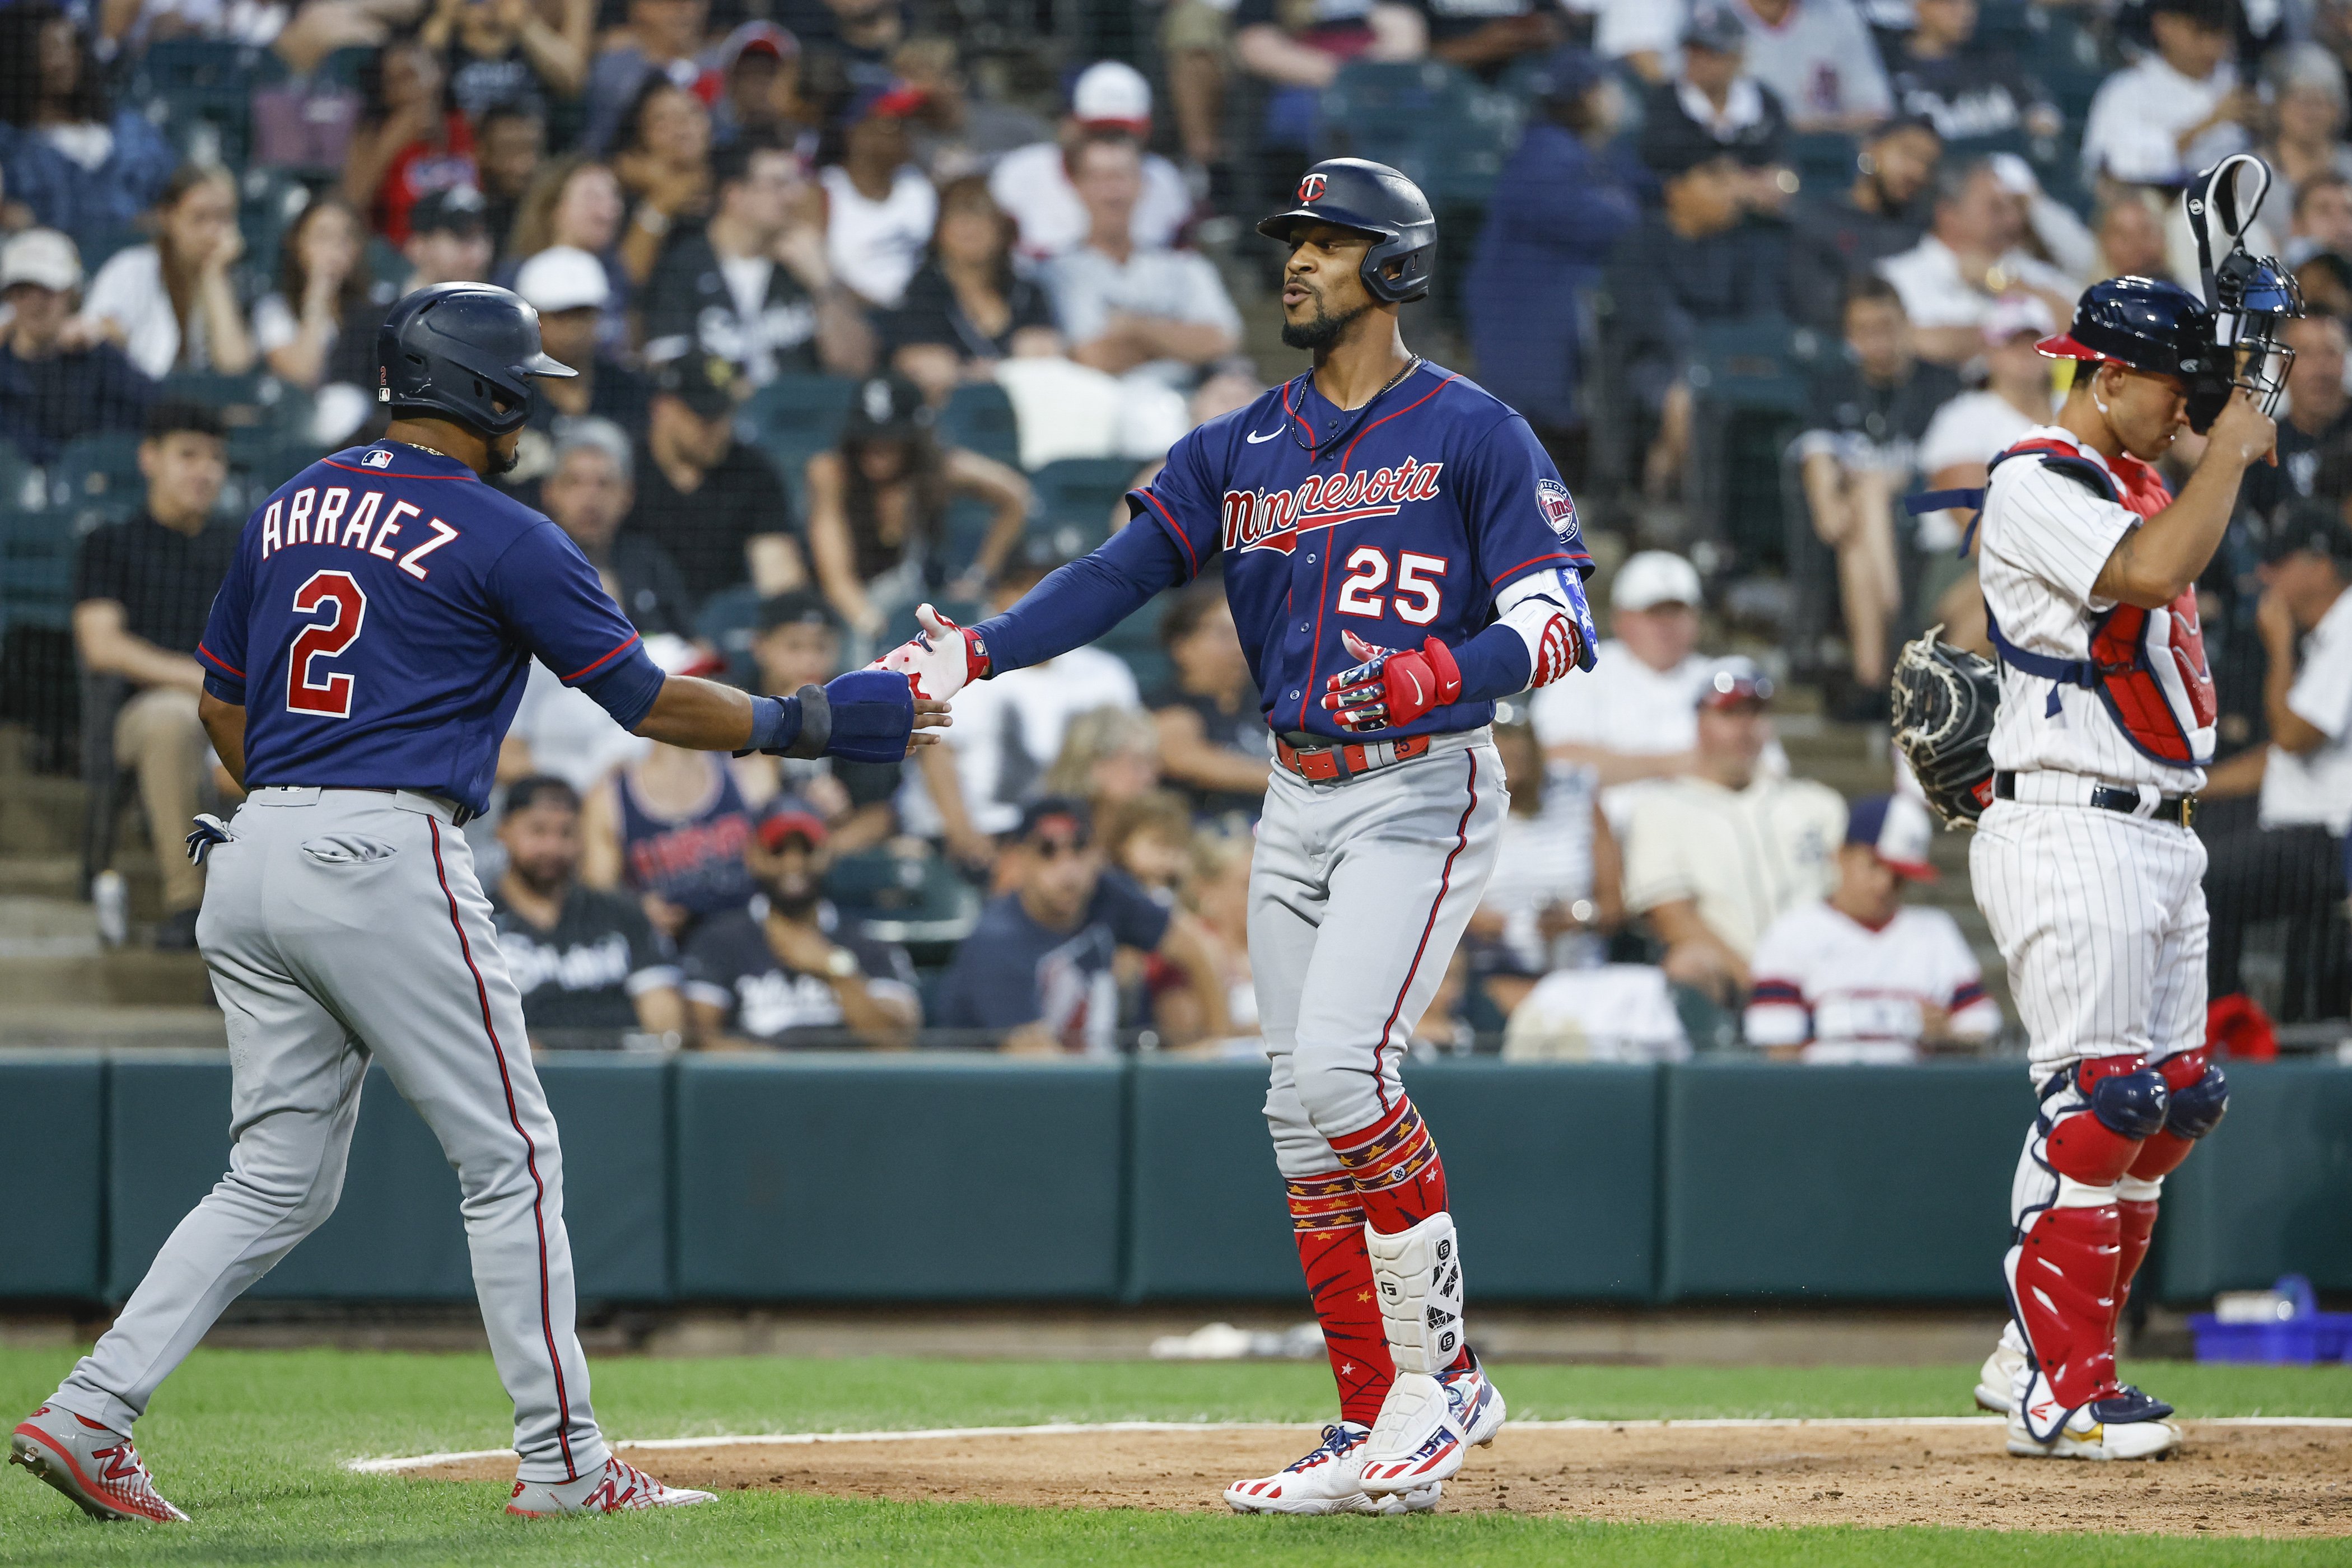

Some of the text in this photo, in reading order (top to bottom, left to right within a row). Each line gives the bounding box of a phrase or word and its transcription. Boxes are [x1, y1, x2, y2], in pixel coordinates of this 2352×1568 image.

[380, 366, 386, 385] 2
[262, 486, 461, 582] ARRAEZ
[1222, 455, 1444, 552] Minnesota
[1566, 522, 1577, 536] CLUB
[1335, 544, 1449, 627] 25
[286, 569, 367, 719] 2
